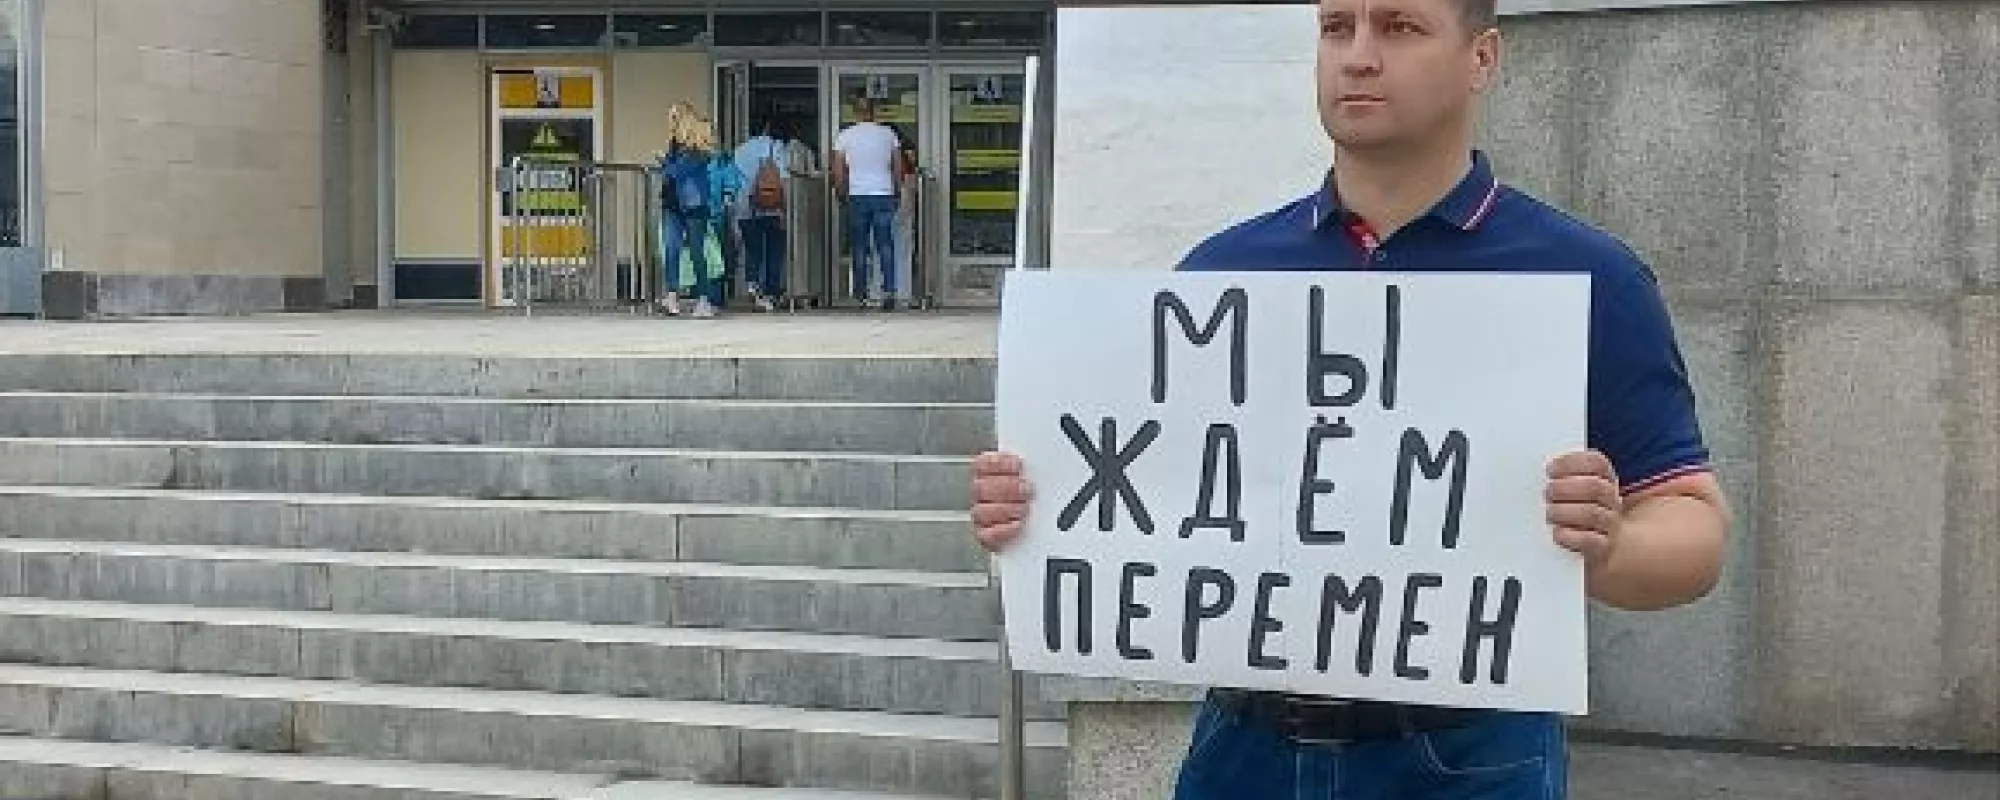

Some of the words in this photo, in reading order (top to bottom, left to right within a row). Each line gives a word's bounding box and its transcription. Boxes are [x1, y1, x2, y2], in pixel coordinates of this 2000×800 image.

[1150, 284, 1401, 411] МЫ
[1056, 412, 1470, 549] ЖДЁМ
[1043, 558, 1522, 685] ПЕРЕМЕН
